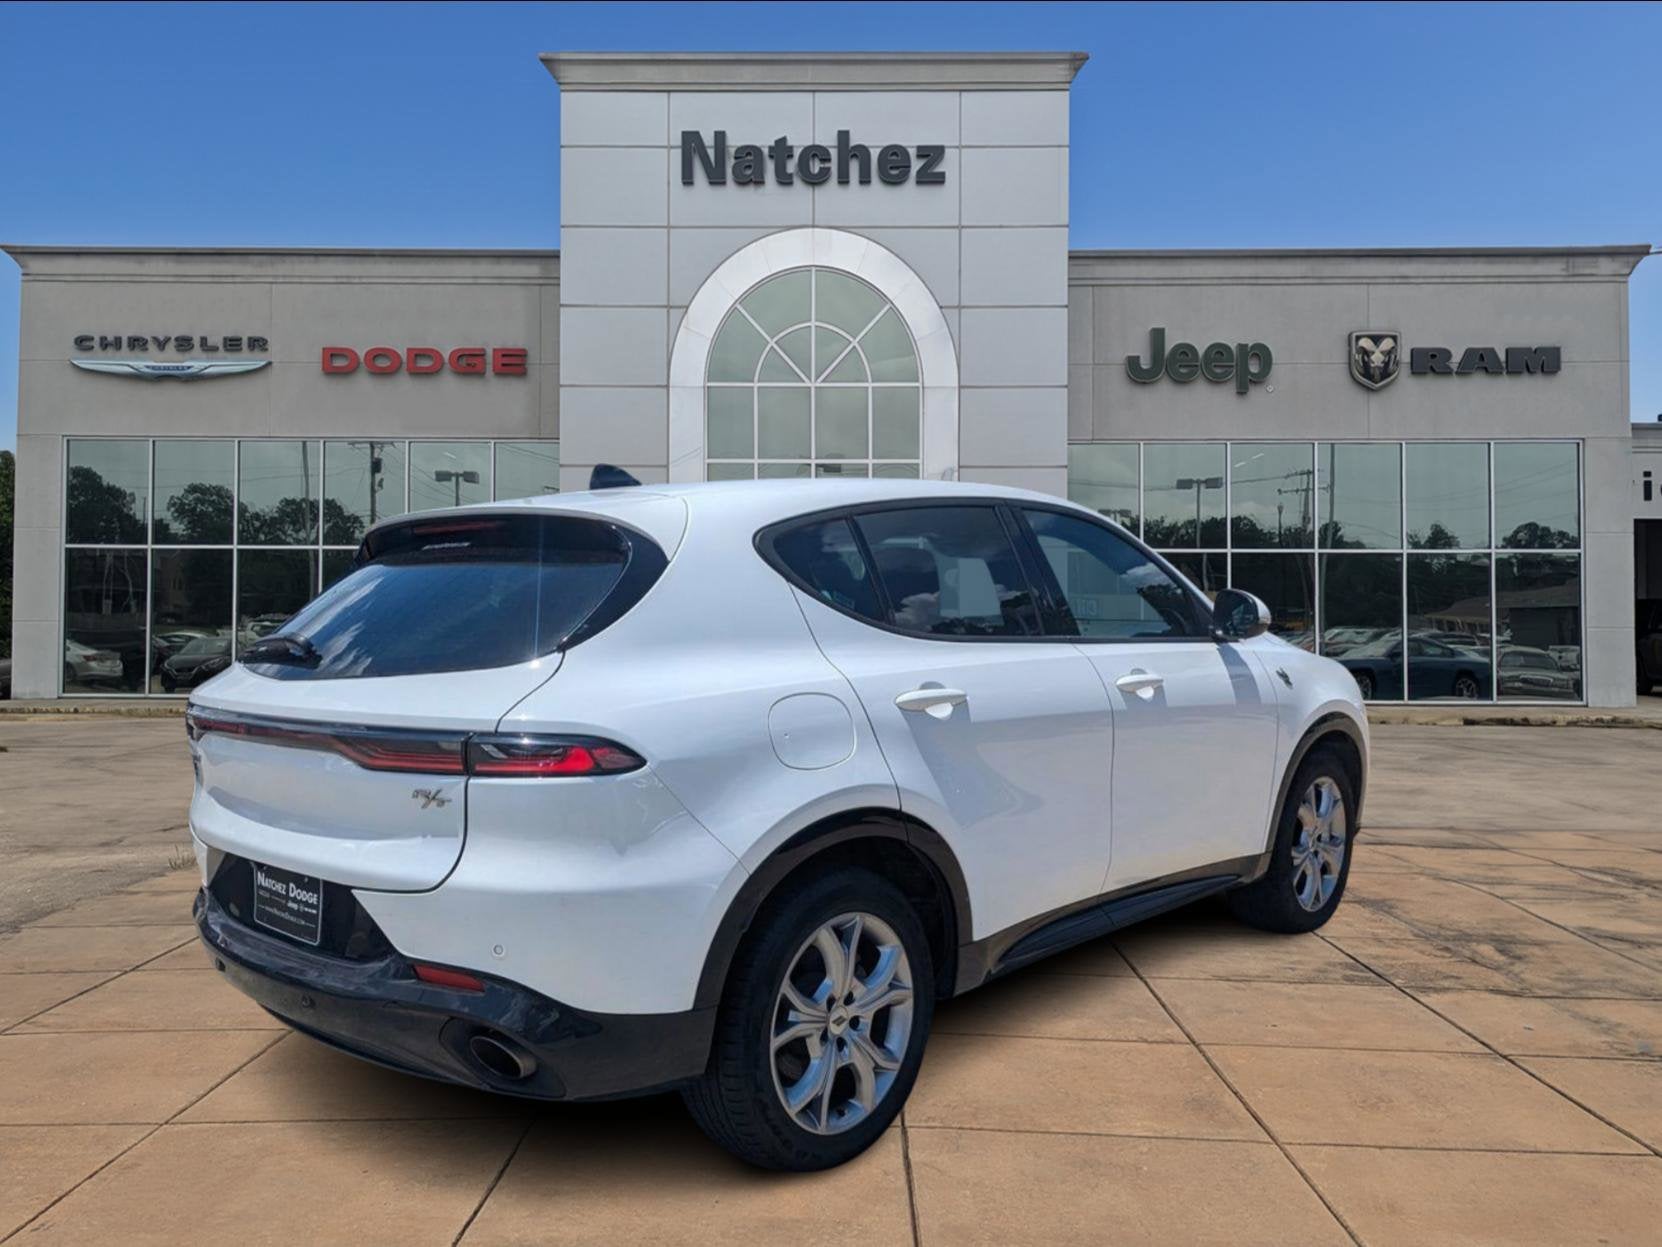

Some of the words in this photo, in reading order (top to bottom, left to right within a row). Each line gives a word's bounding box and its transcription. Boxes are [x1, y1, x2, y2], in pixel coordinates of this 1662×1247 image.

[681, 130, 946, 185] Natchez
[74, 335, 269, 352] CHRYSLER
[321, 347, 528, 375] DODGE
[1127, 327, 1273, 394] Jeep
[1410, 346, 1562, 374] RAM
[257, 871, 286, 895] NATCHEZ
[288, 882, 318, 904] DODGE
